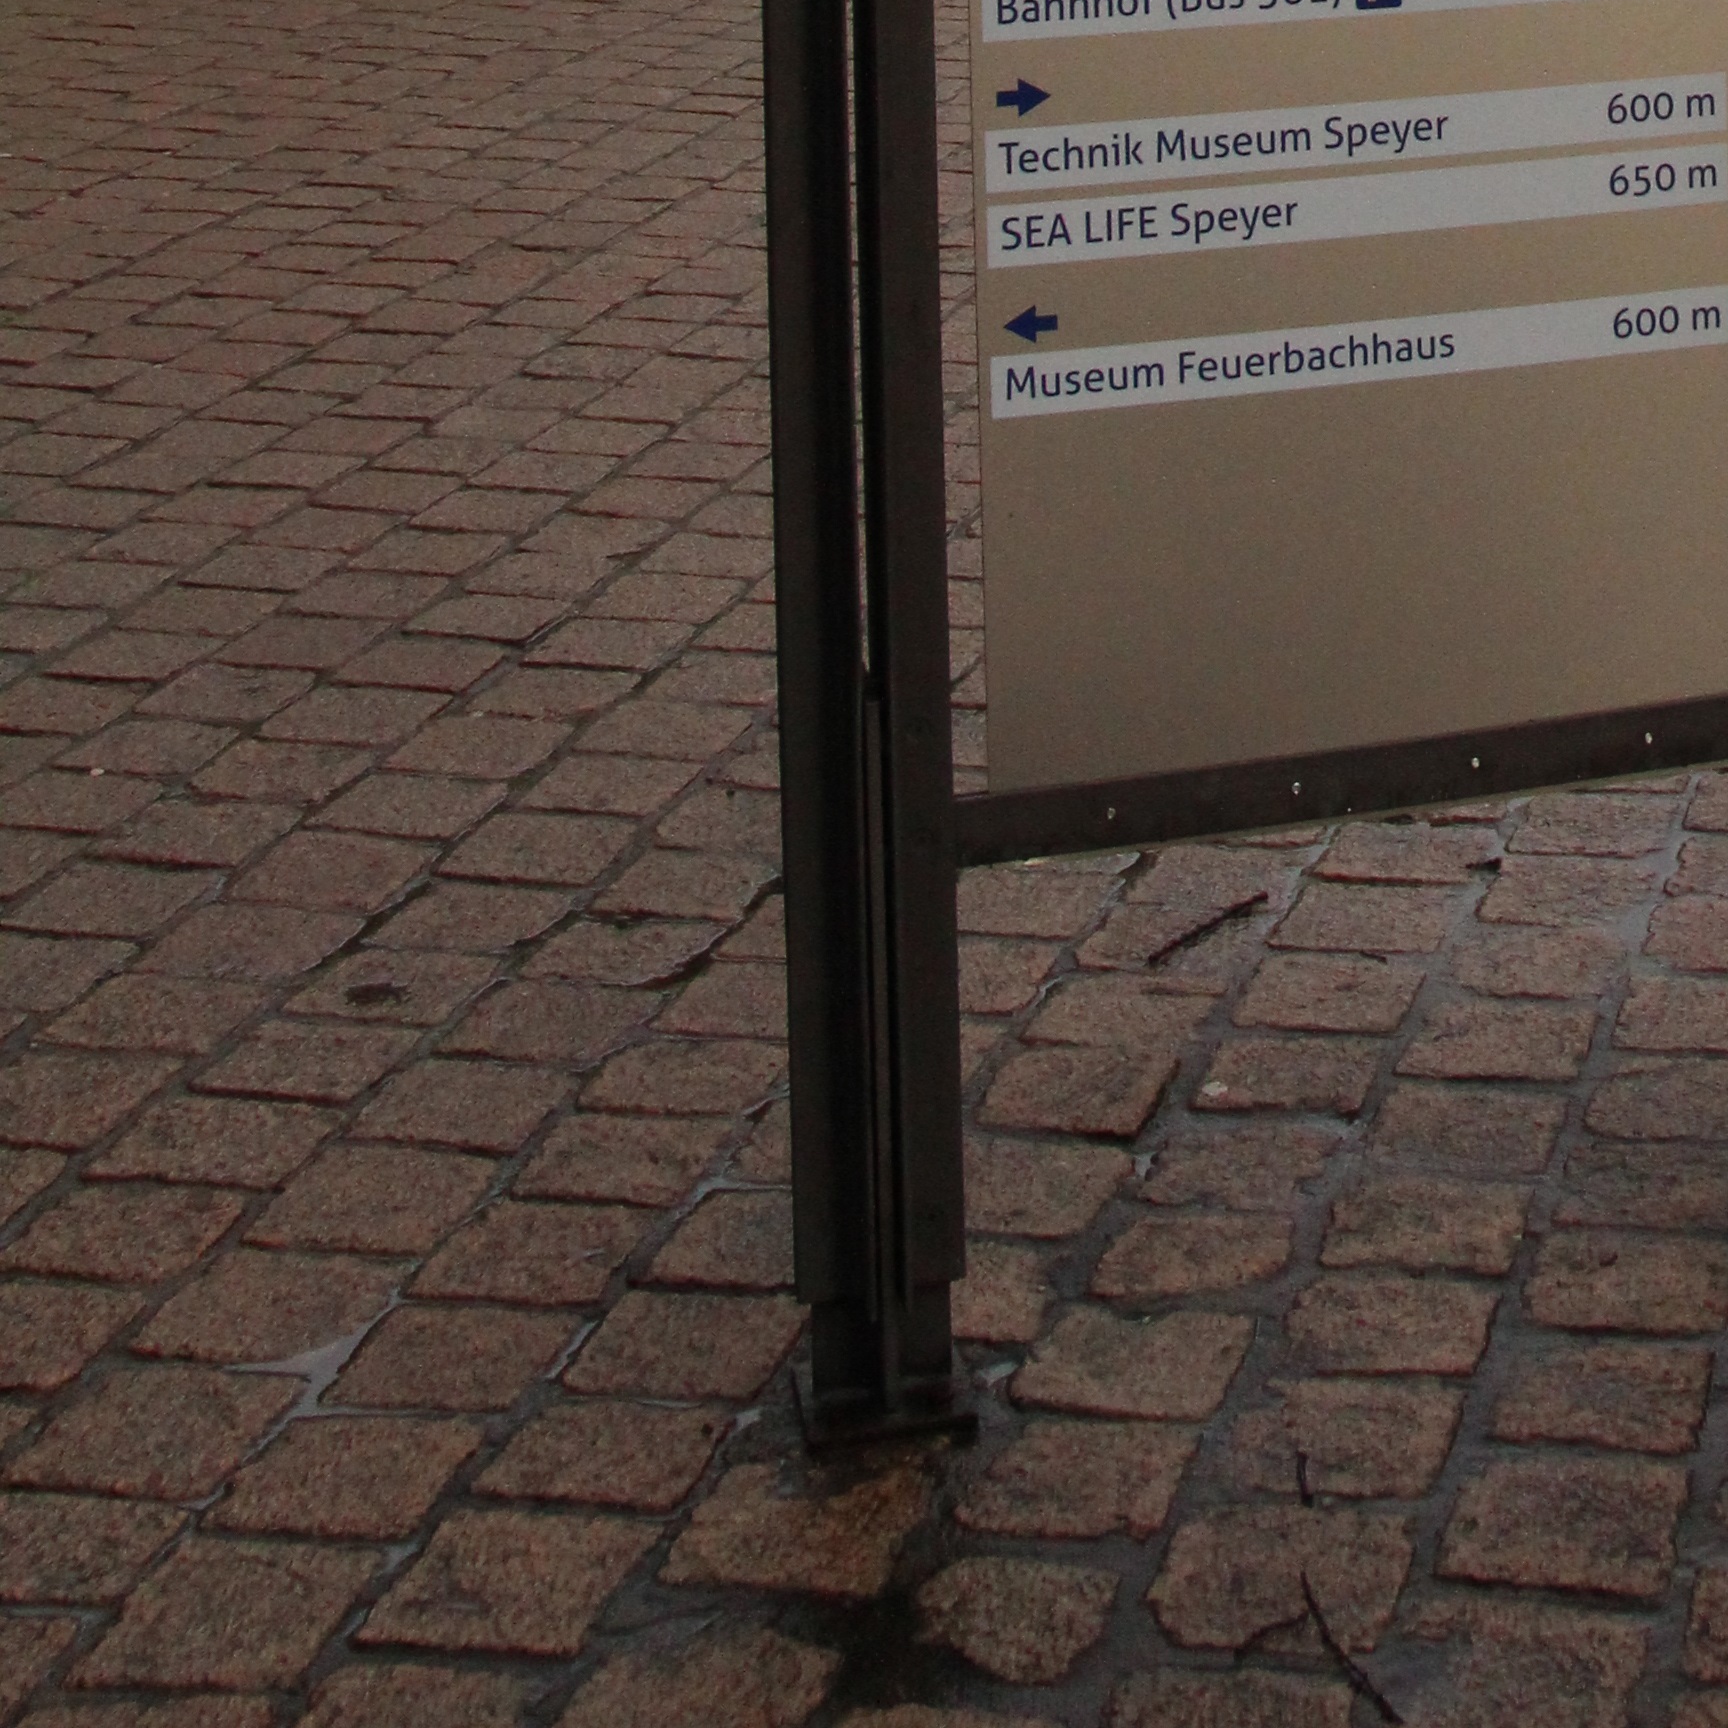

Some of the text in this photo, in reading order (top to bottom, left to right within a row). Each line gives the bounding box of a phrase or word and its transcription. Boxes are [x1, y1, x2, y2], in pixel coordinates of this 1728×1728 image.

[1607, 92, 1715, 125] 600 m
[997, 116, 1449, 175] Technik Museum Speyer
[1609, 163, 1717, 197] 650 m
[1001, 202, 1298, 251] SEA LIFE Speyer
[1613, 305, 1721, 339] 600 m
[1006, 332, 1455, 401] Museum Feuerbachhaus
